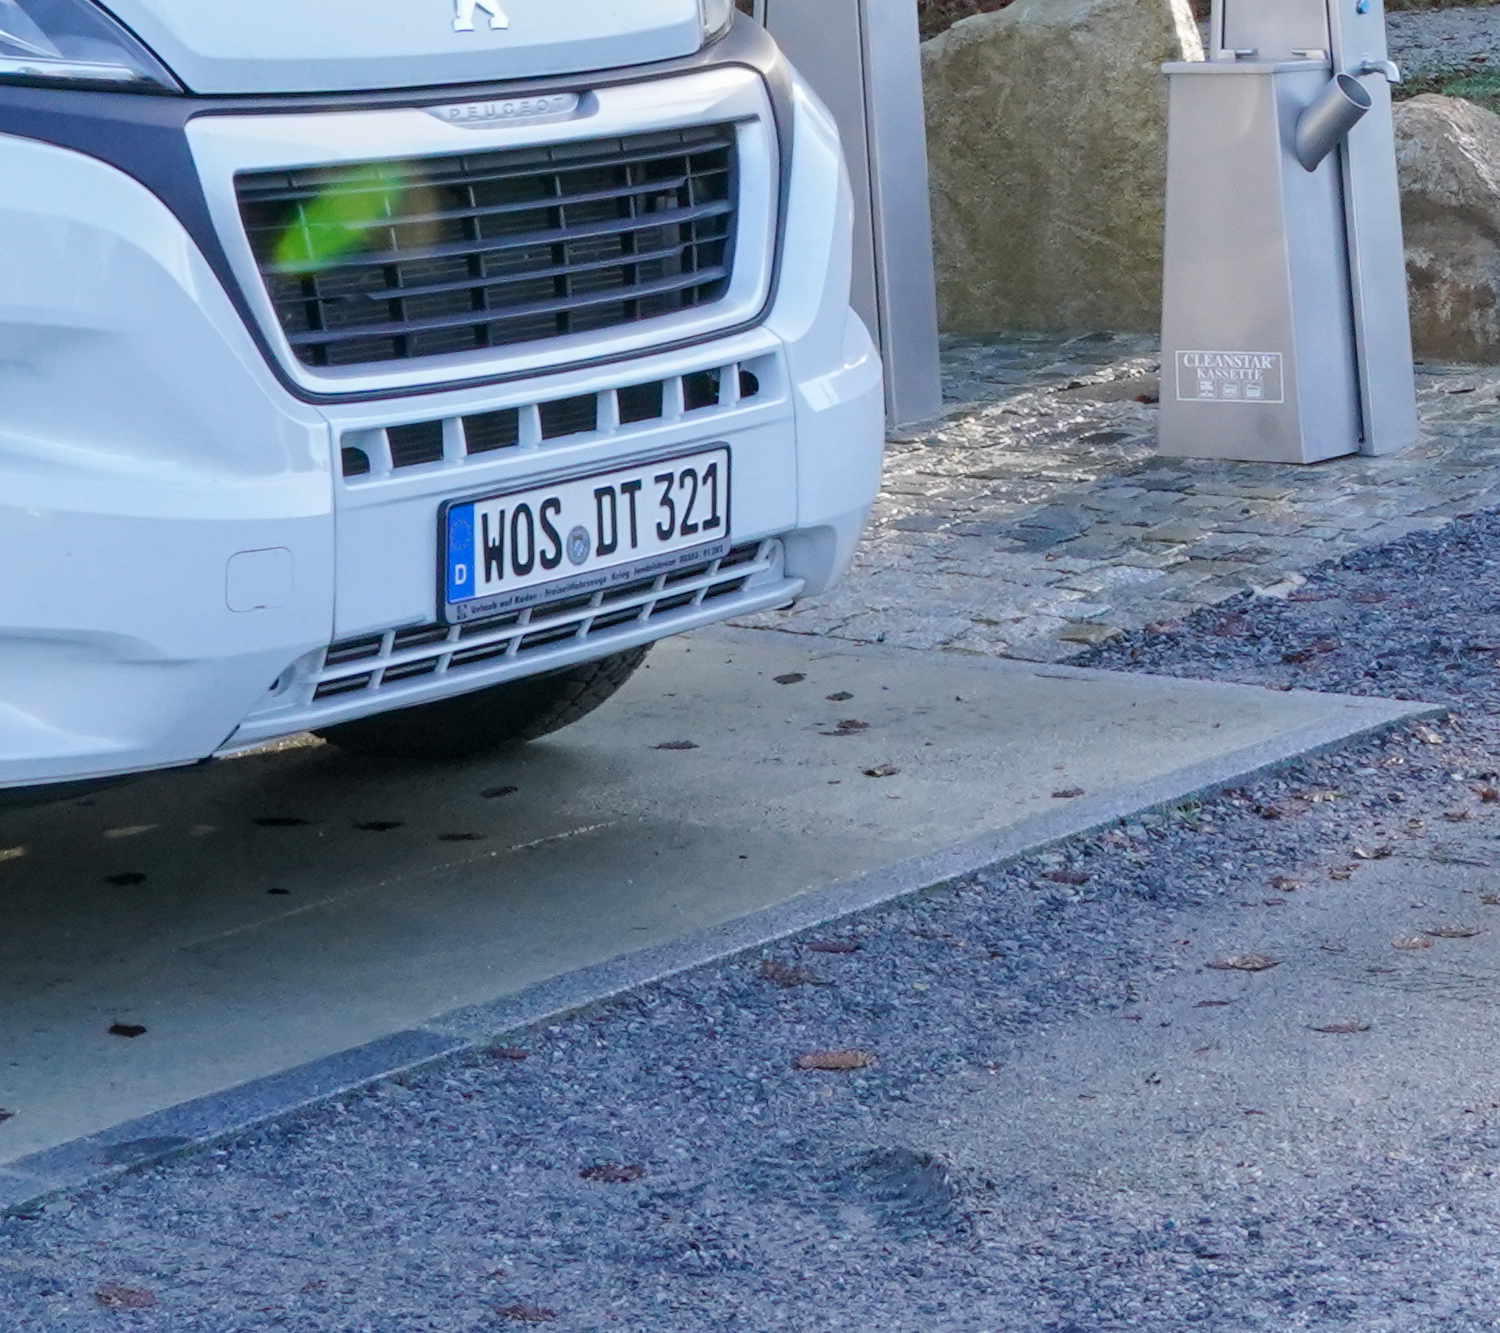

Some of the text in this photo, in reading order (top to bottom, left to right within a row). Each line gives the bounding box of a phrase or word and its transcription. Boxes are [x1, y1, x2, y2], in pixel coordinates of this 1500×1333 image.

[449, 96, 563, 120] PEUGEOT
[1197, 368, 1263, 380] KASSETTE
[481, 462, 721, 583] WOS DT 321
[454, 564, 467, 585] D
